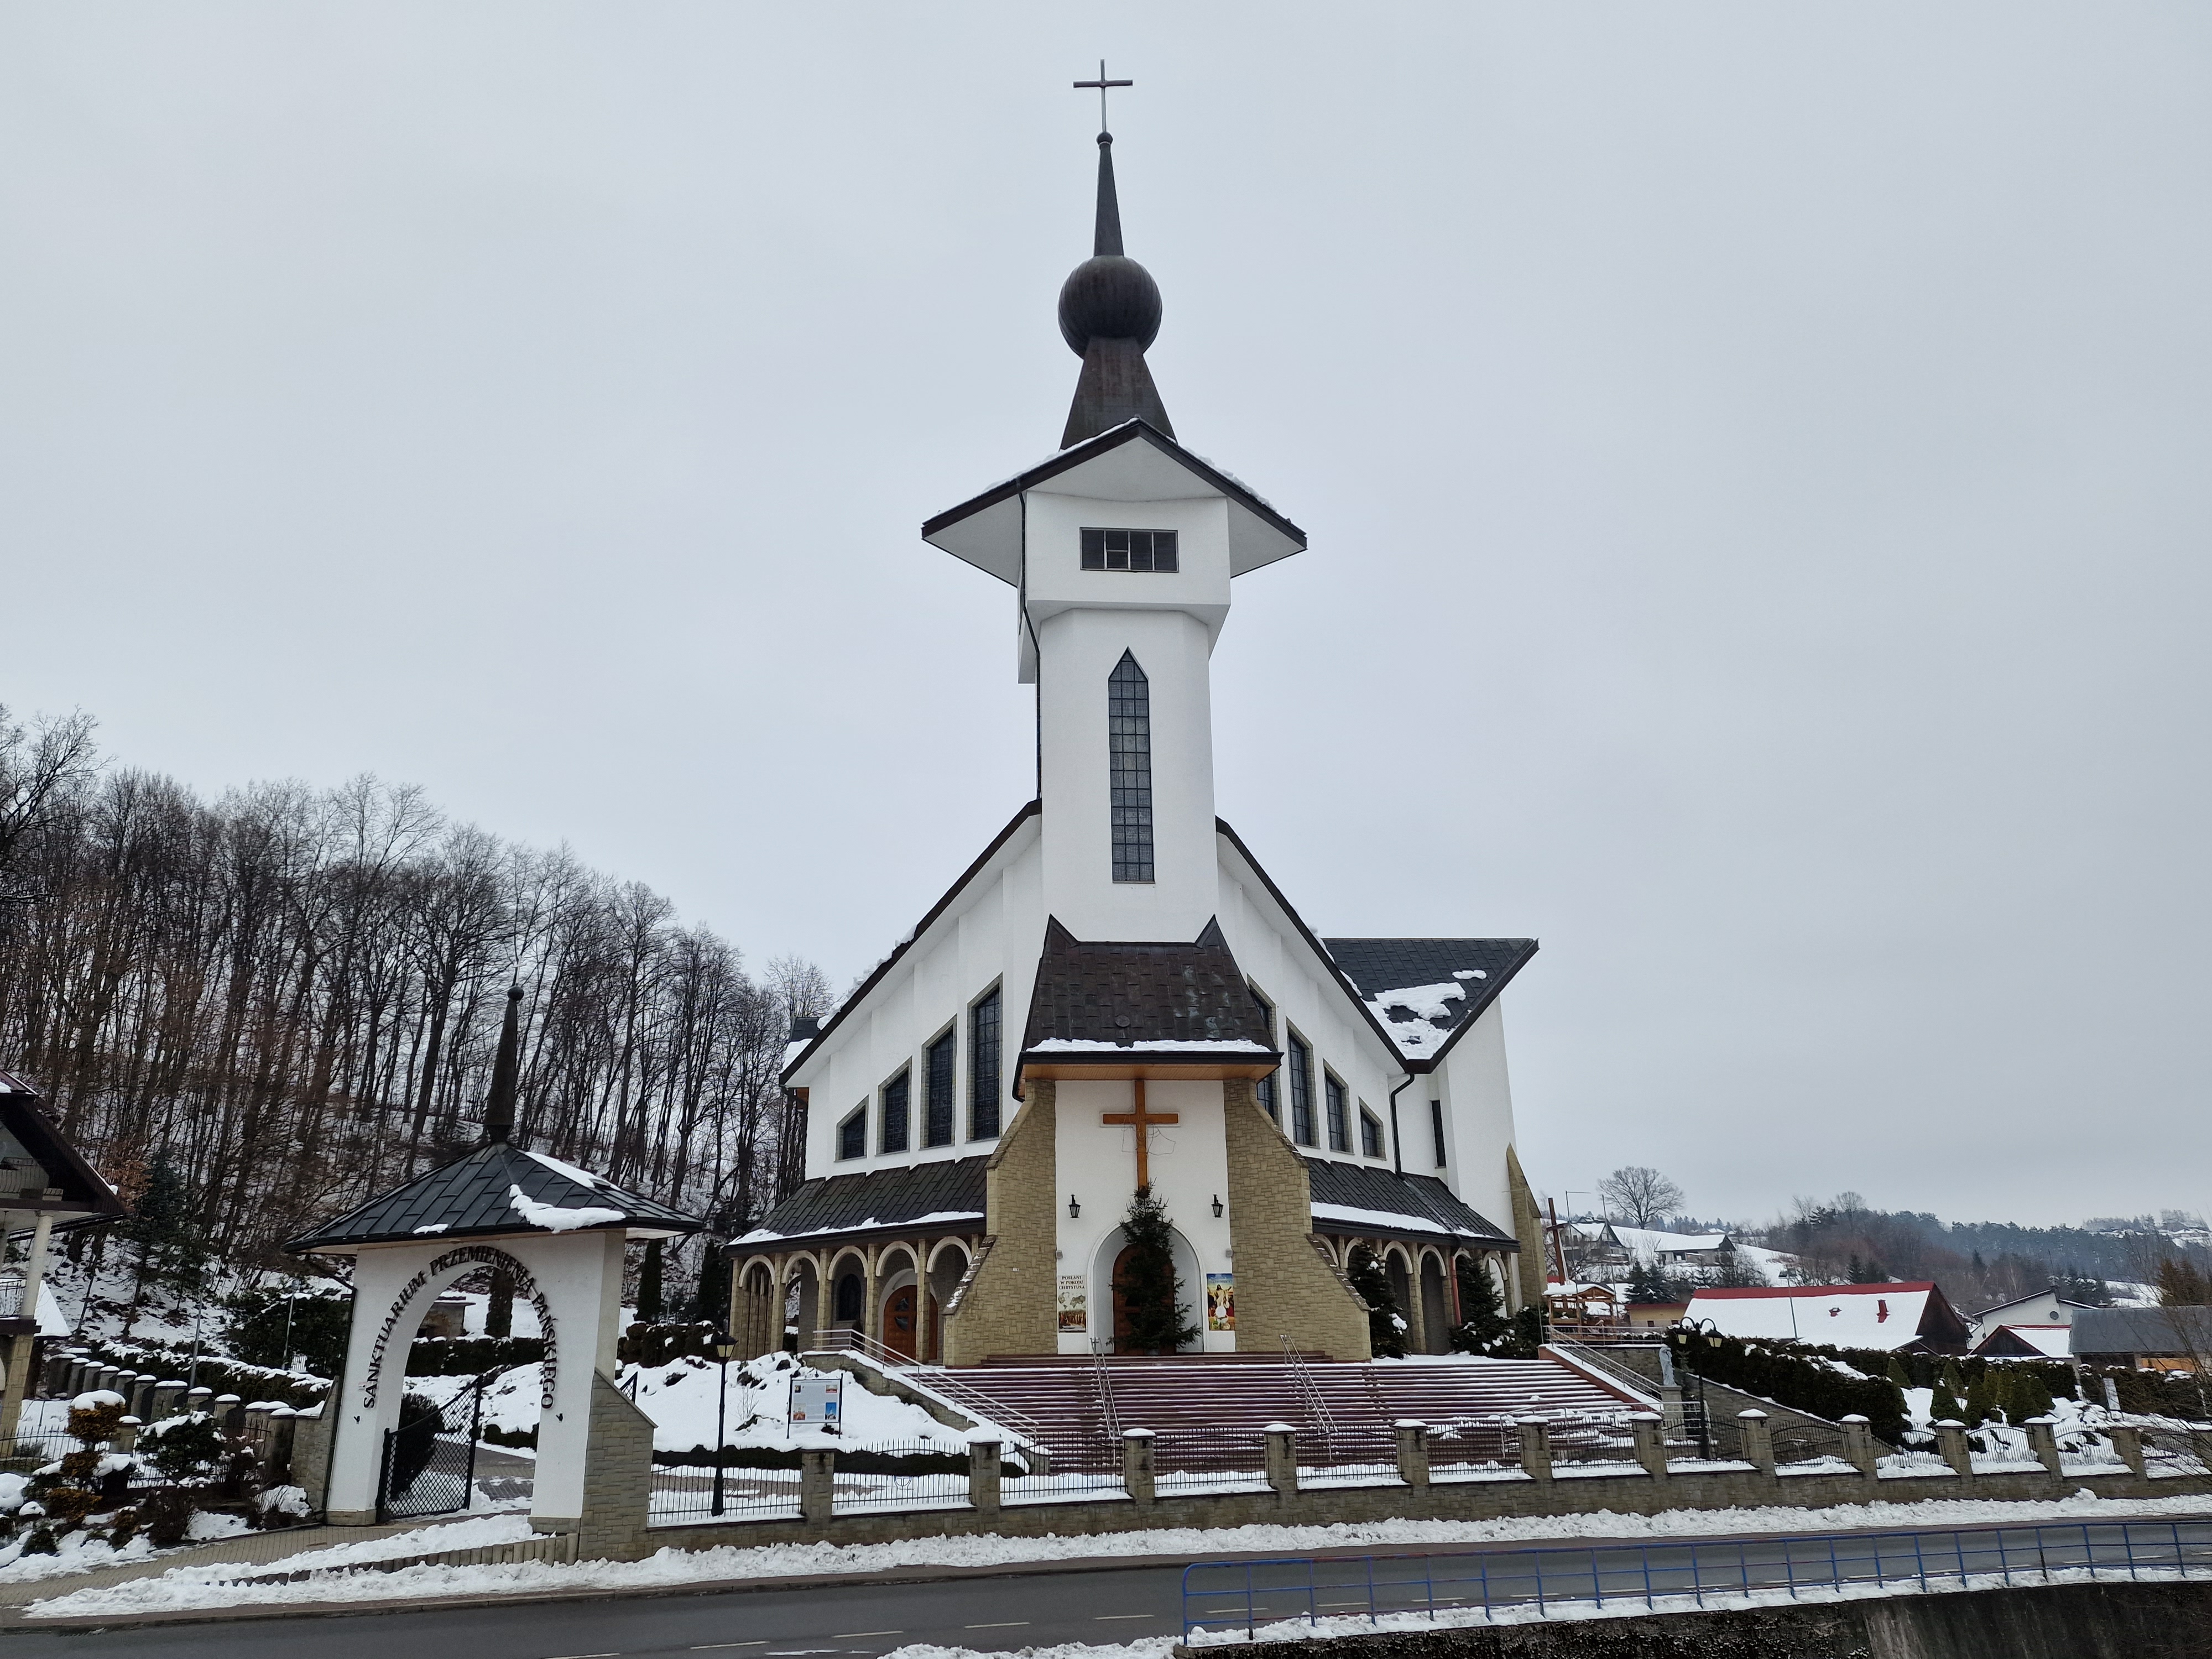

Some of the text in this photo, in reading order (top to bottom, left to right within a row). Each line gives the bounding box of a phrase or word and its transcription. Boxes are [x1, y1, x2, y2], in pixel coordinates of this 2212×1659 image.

[363, 1246, 558, 1409] SANKTUARIUM PRZEMIENIENIA PAŃSKIEGO
